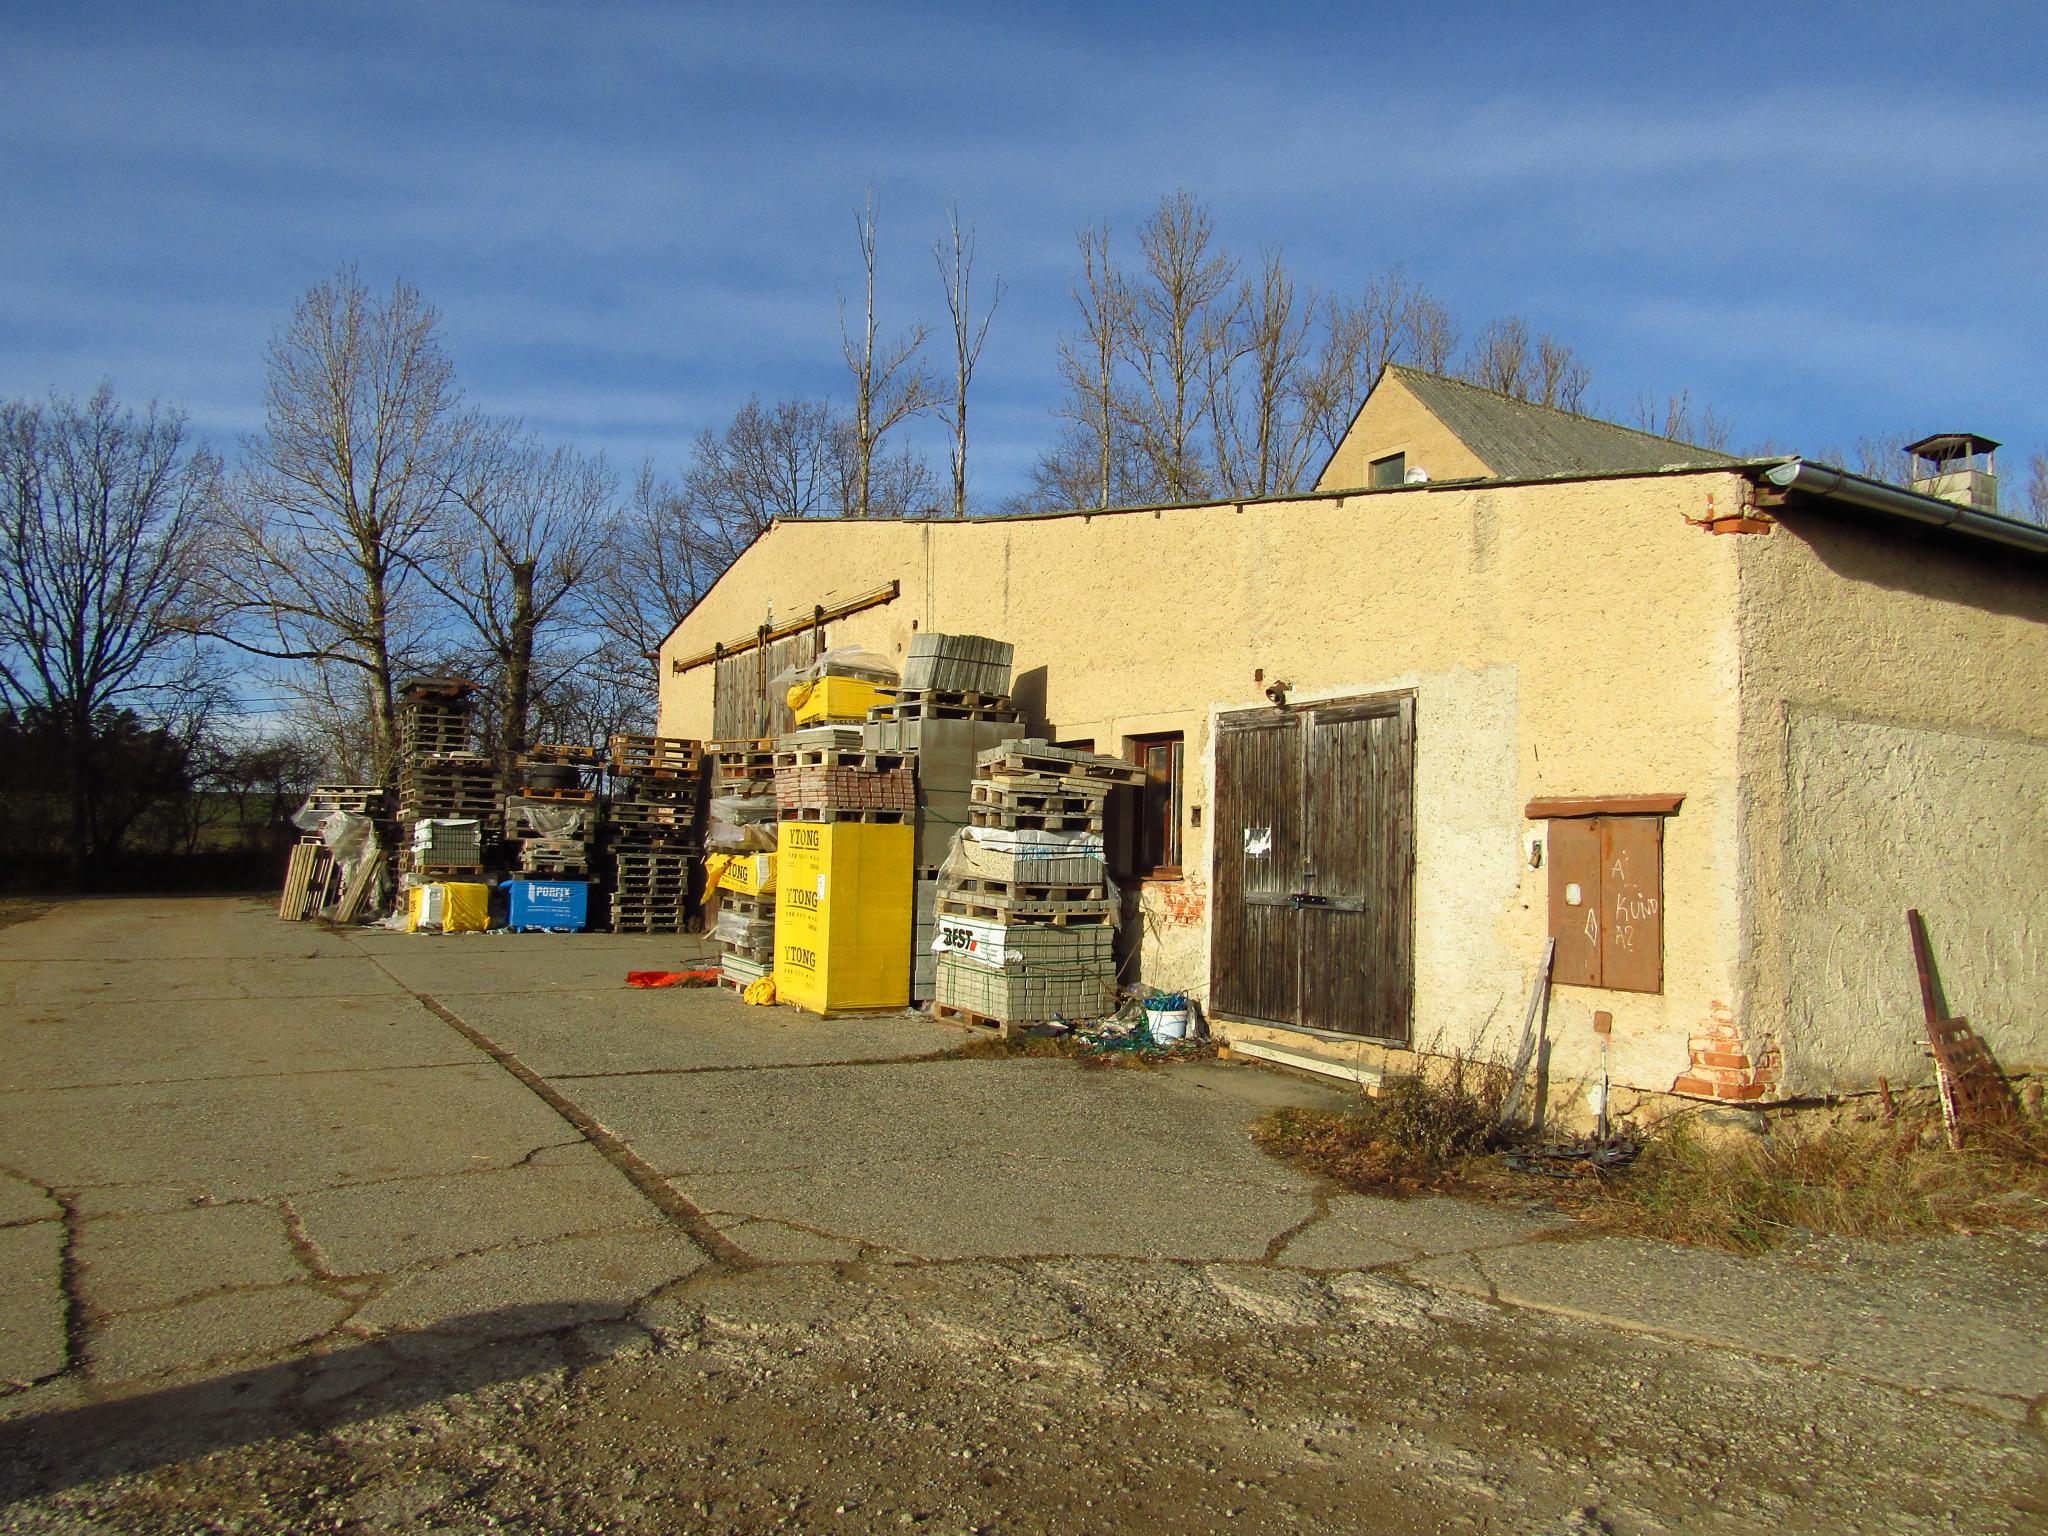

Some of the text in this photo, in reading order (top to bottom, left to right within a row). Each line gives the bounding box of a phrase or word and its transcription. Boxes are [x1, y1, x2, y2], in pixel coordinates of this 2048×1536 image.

[790, 829, 819, 846] YTONG
[1611, 859, 1625, 880] A
[536, 886, 570, 898] PORFIX
[785, 888, 818, 908] YTONG
[943, 927, 974, 950] BEST
[784, 946, 816, 968] YTONG
